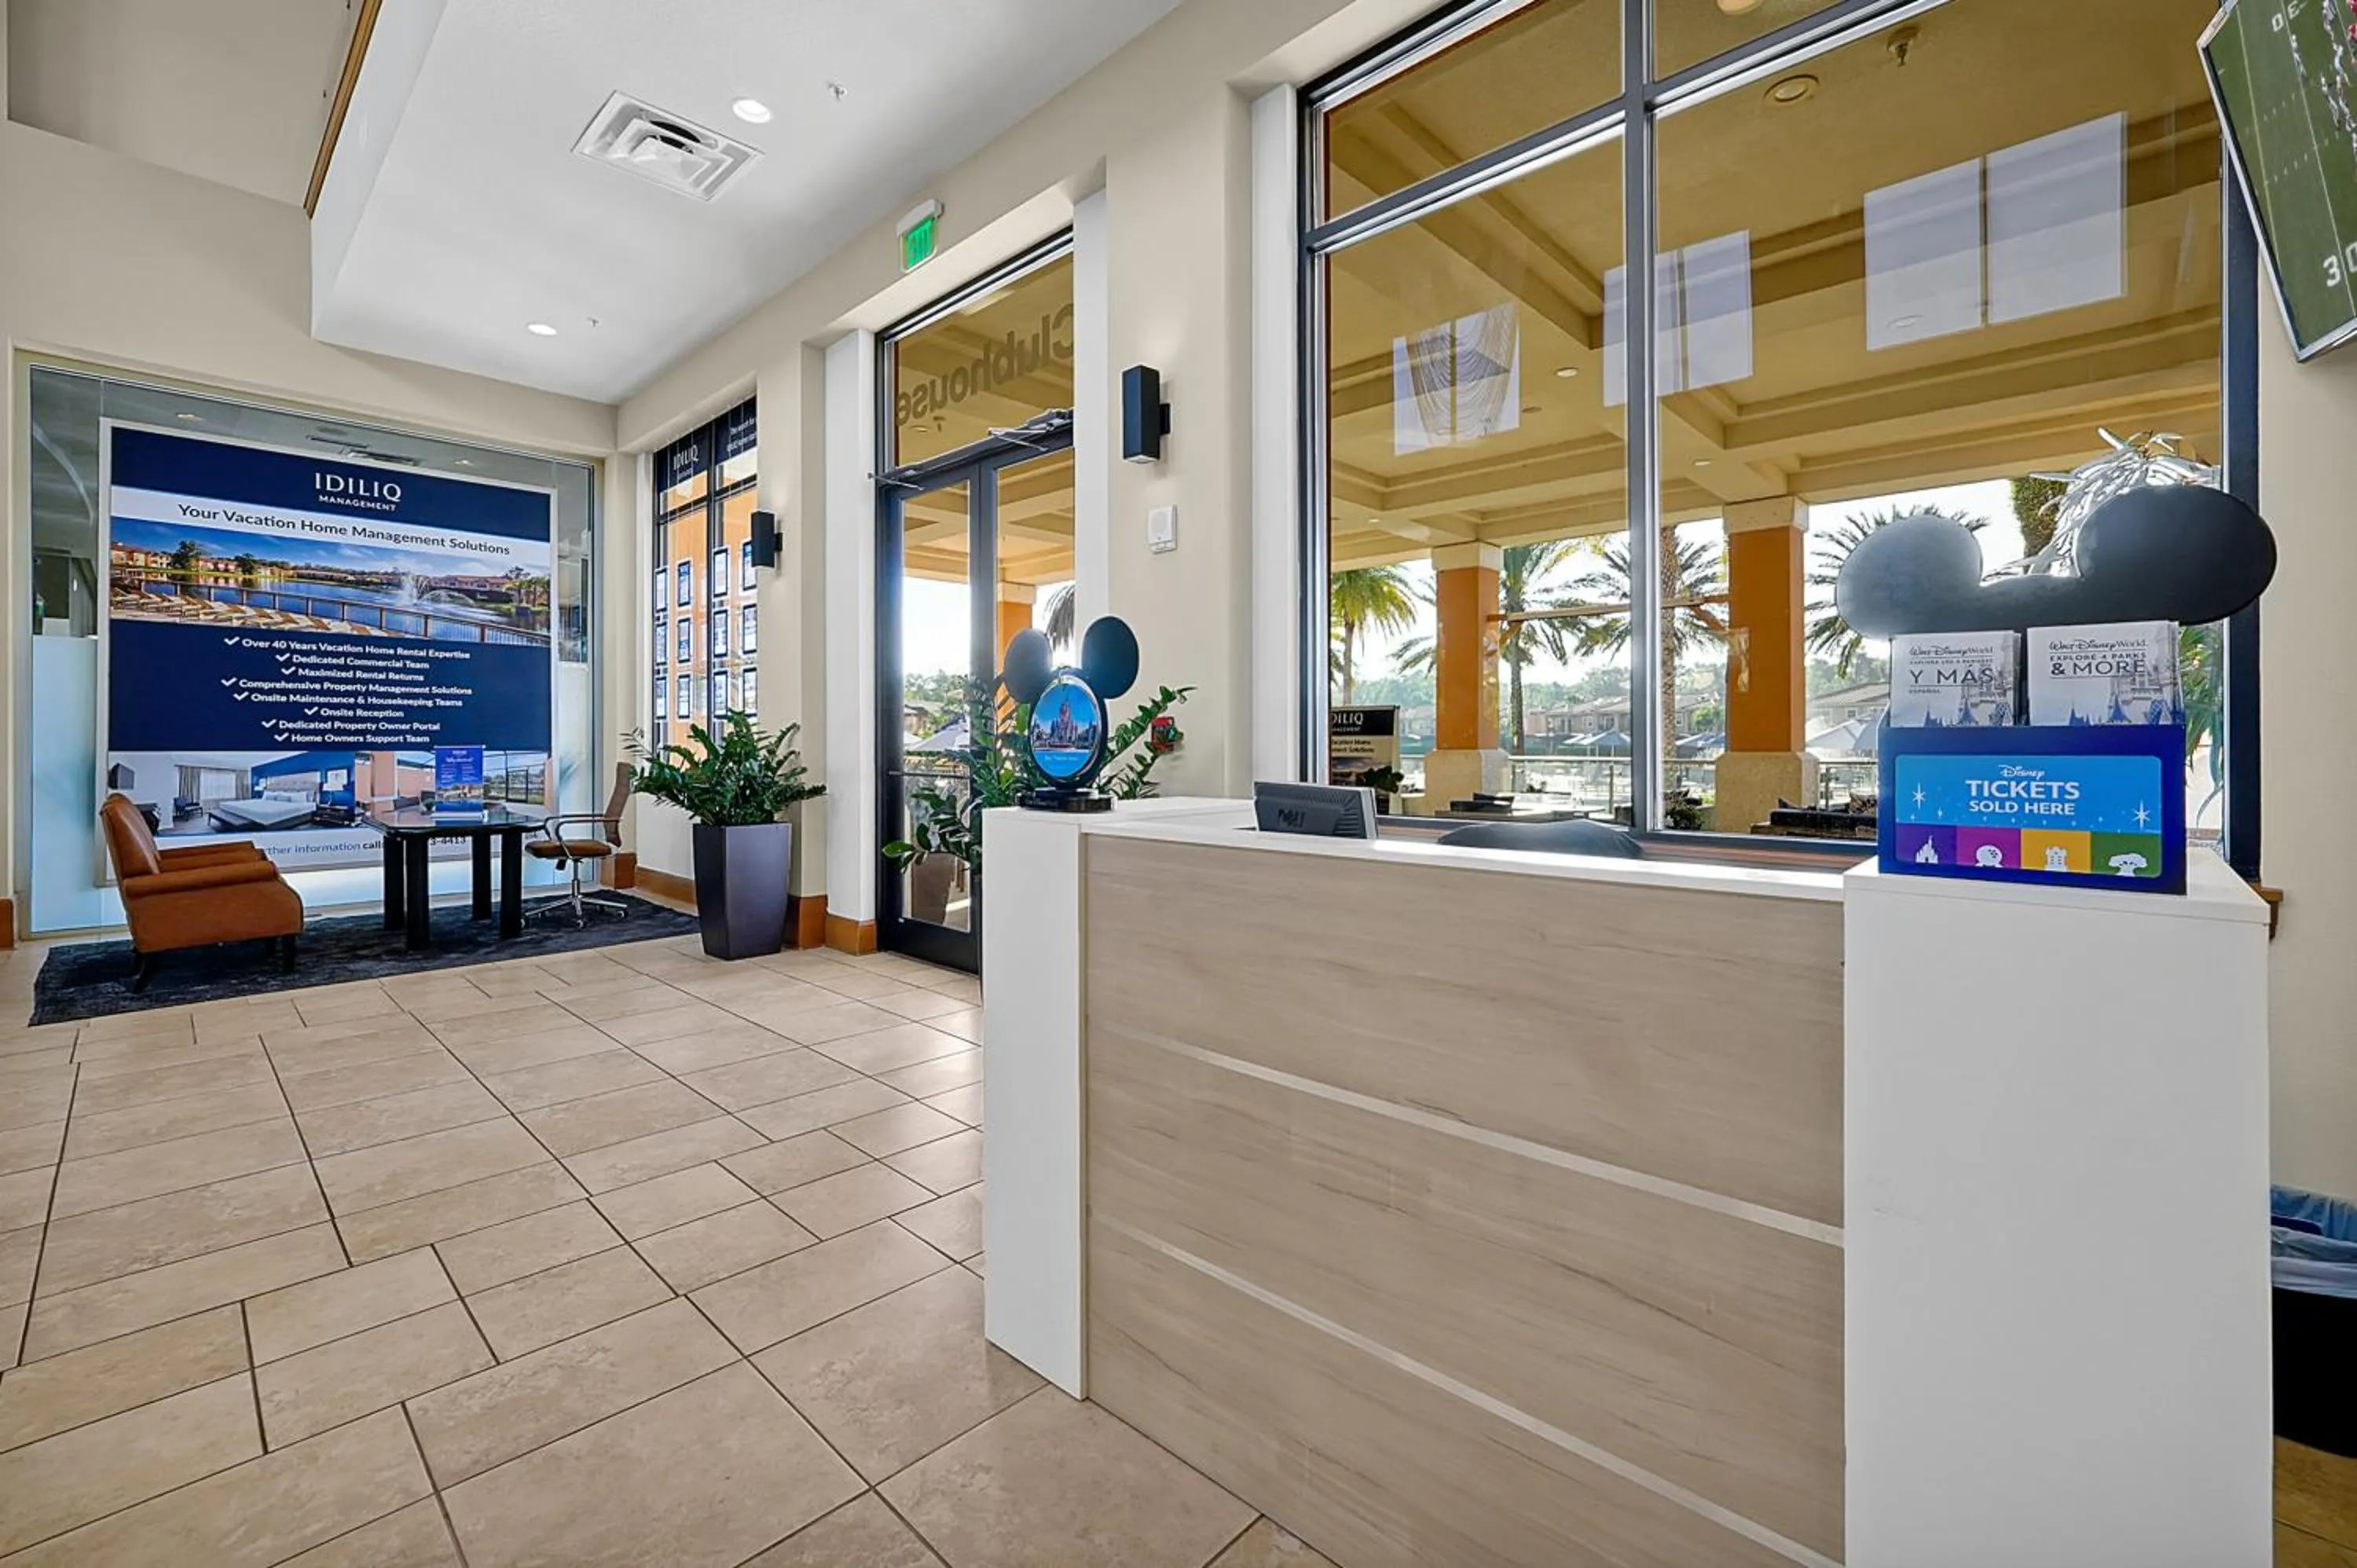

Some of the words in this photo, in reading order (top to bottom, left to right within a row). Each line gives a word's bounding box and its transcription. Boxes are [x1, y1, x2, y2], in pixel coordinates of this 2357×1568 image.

[315, 472, 401, 502] IDILIQ
[318, 494, 397, 511] MANAGEMENT
[178, 504, 220, 520] Your
[222, 509, 296, 529] Vacation
[301, 519, 347, 536] Home
[353, 526, 445, 548] Management
[449, 537, 510, 555] Solutions
[242, 639, 270, 648] Over
[272, 640, 287, 649] 40
[288, 641, 317, 650] Years
[318, 643, 363, 652] Vacation
[365, 645, 394, 654] Home
[397, 647, 426, 657] Rental
[428, 649, 471, 659] Expertise
[292, 654, 344, 665] Dedicated
[346, 658, 403, 667] Commercial
[2051, 662, 2066, 676] &
[2073, 660, 2145, 675] MORE
[298, 669, 354, 678] Maximized
[356, 671, 386, 680] Rental
[388, 672, 424, 681] Returns
[1910, 669, 1923, 683] Y
[1937, 664, 1993, 683] MÁS
[239, 680, 321, 690] Comprehensive
[323, 682, 366, 691] Property
[368, 683, 430, 694] Management
[431, 686, 472, 694] Solutions
[251, 693, 287, 702] Onsite
[289, 694, 355, 703] Maintenance
[368, 697, 434, 707] Housekeeping
[321, 708, 354, 716] Onsite
[356, 709, 404, 718] Reception
[1332, 713, 1364, 725] DILIQ
[279, 720, 332, 729] Dedicated
[334, 721, 377, 731] Property
[412, 722, 441, 731] Portal
[291, 734, 322, 742] Home
[324, 734, 364, 742] Owners
[366, 735, 404, 744] Support
[1998, 764, 2045, 780] Disney
[1965, 780, 2080, 799] TICKETS
[1969, 800, 2018, 813] SOLD
[2024, 802, 2076, 815] HERE
[266, 844, 291, 855] ther
[295, 842, 361, 854] information
[362, 840, 381, 850] call
